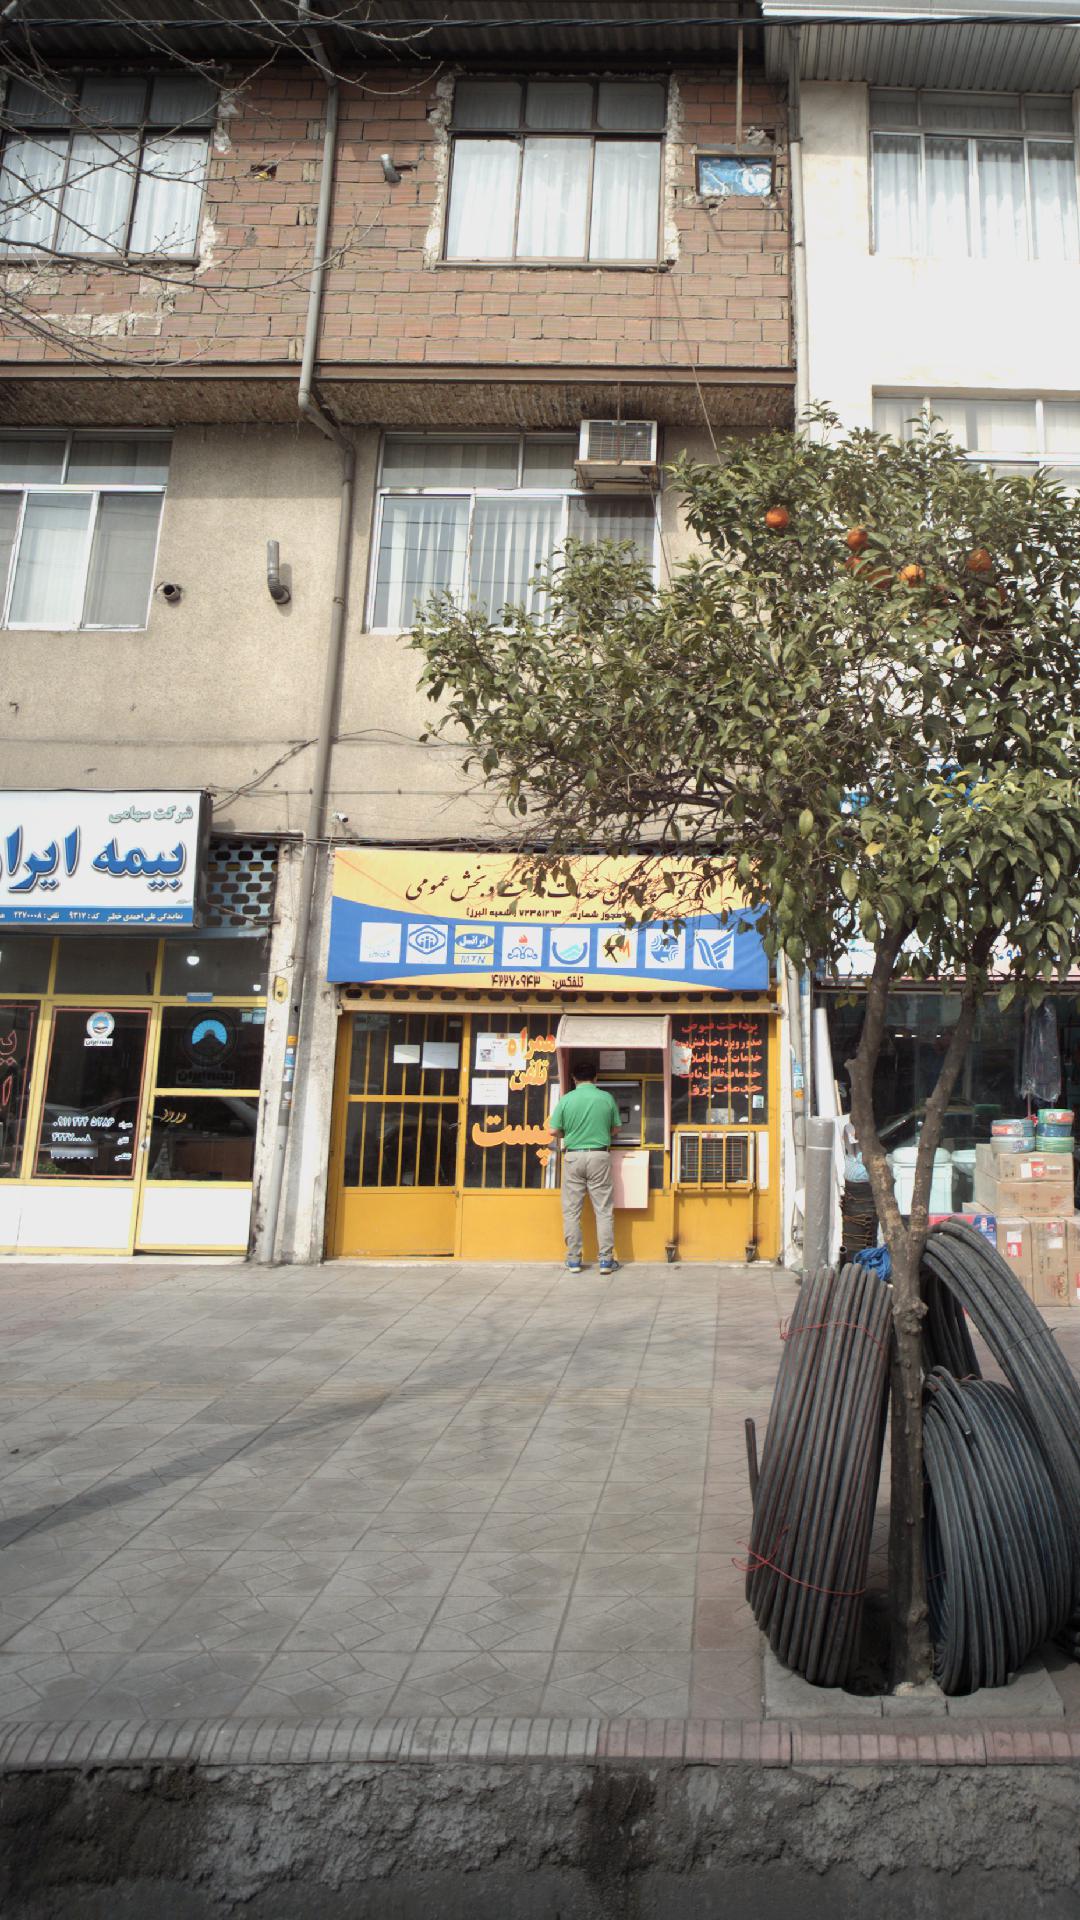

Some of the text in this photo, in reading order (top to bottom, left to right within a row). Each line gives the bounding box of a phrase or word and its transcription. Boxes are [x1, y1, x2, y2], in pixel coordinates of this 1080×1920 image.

[108, 805, 193, 823] شرکت سهامی
[0, 824, 187, 893] بیمه ایرا
[405, 875, 448, 901] عمومی
[450, 865, 487, 902] بخش
[459, 935, 489, 948] ایرانسل
[461, 955, 486, 964] MTN
[716, 1021, 759, 1035] پرداخت
[731, 1052, 762, 1063] خدمات
[509, 1059, 549, 1091] تلفن
[724, 1069, 761, 1079] خدمات
[714, 1083, 763, 1094] خدمات
[472, 1115, 554, 1166] پست
